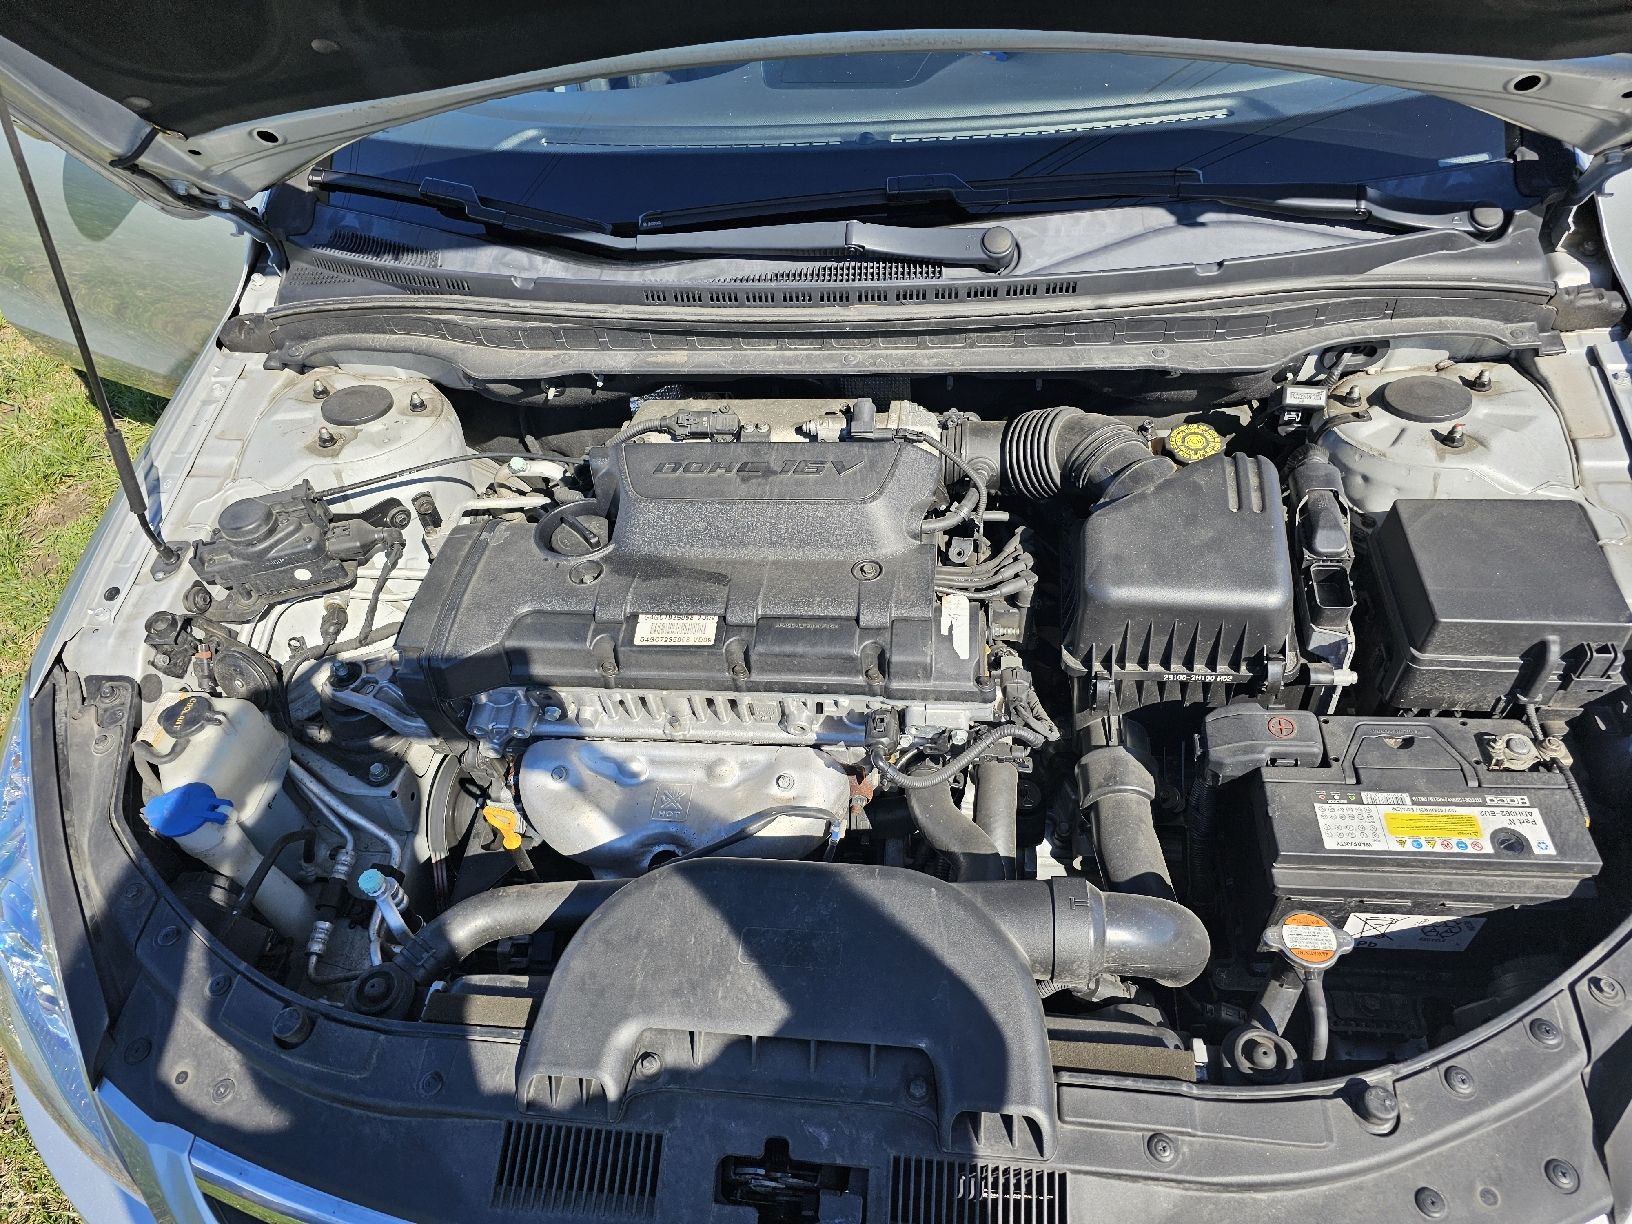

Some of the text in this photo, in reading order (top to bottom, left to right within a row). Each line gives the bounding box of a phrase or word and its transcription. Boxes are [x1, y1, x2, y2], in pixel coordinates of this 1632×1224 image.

[652, 459, 865, 477] DOHC 16V
[173, 697, 198, 731] COOLANT
